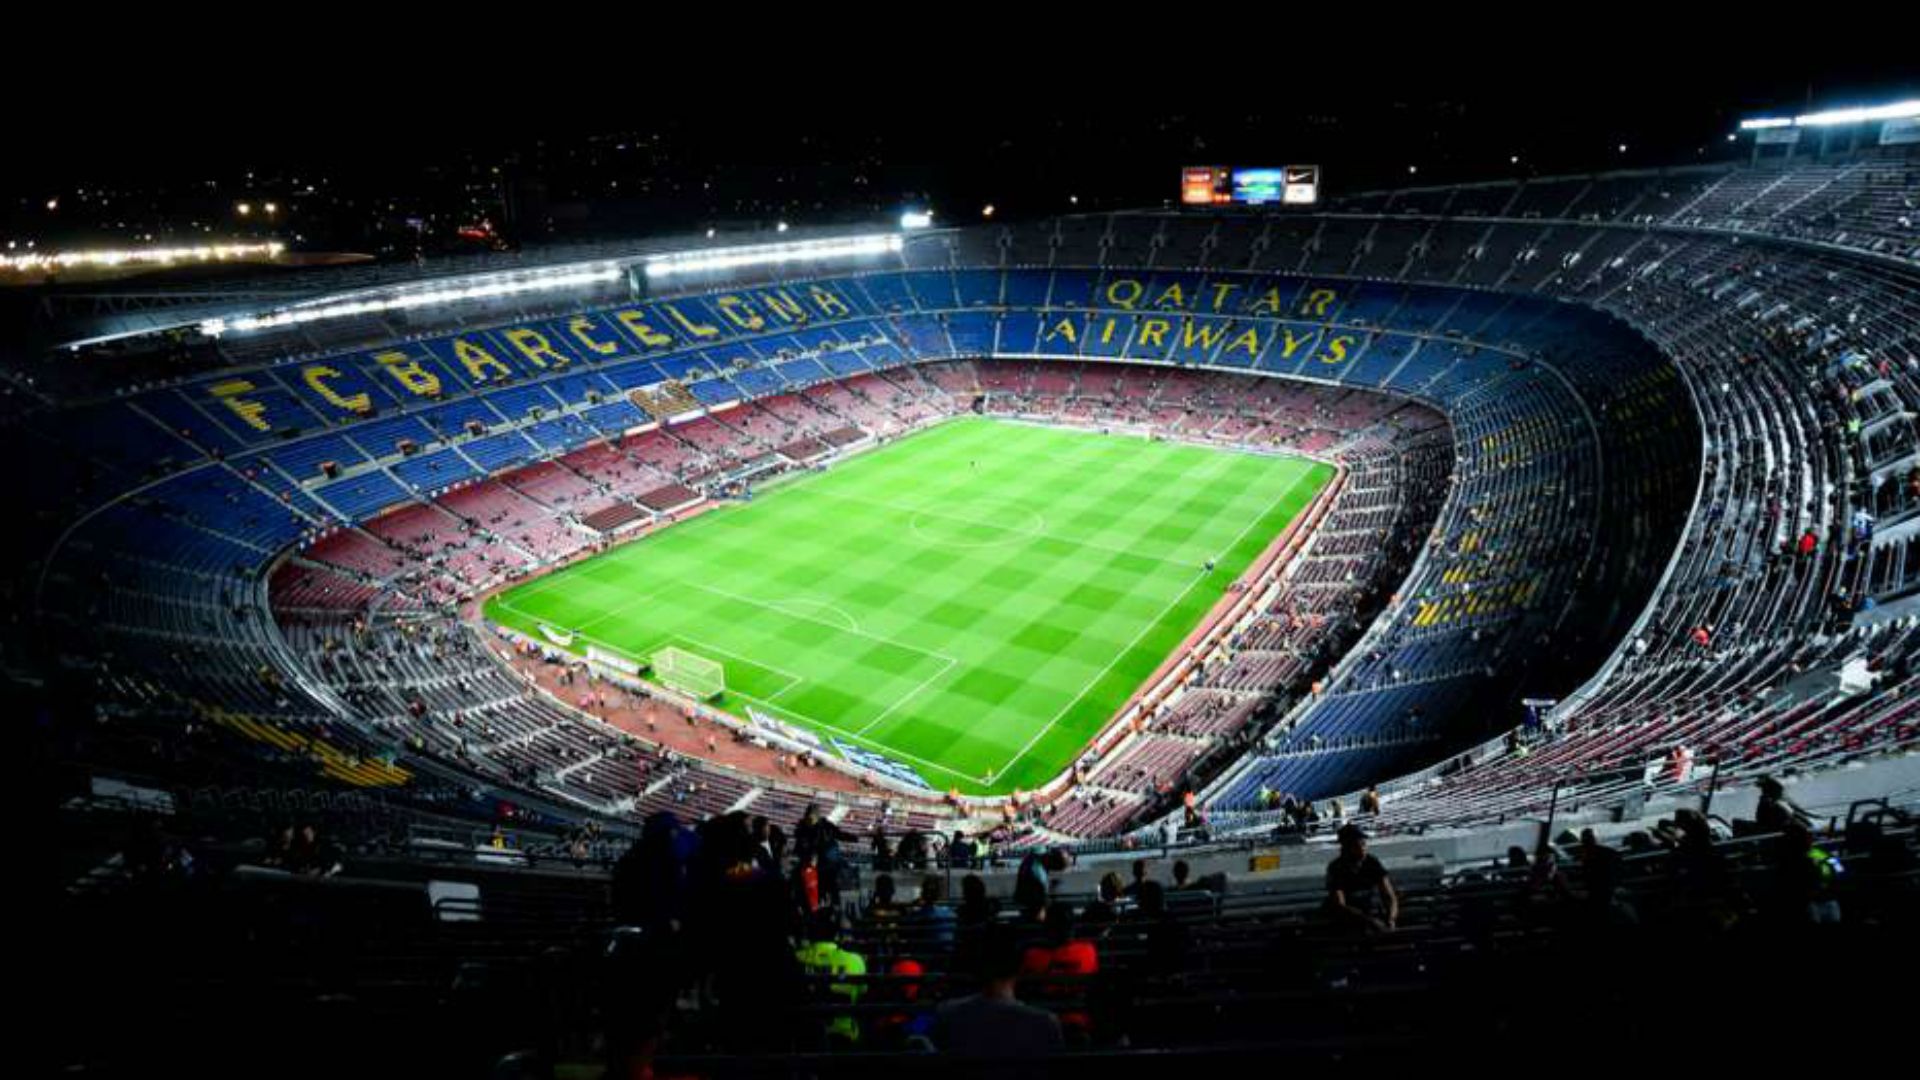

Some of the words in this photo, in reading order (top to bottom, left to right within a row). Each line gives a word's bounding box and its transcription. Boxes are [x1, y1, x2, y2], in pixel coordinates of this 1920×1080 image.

[1106, 279, 1336, 316] QATAR
[376, 284, 850, 397] BARCELONA
[1046, 317, 1355, 365] AIRWAYS
